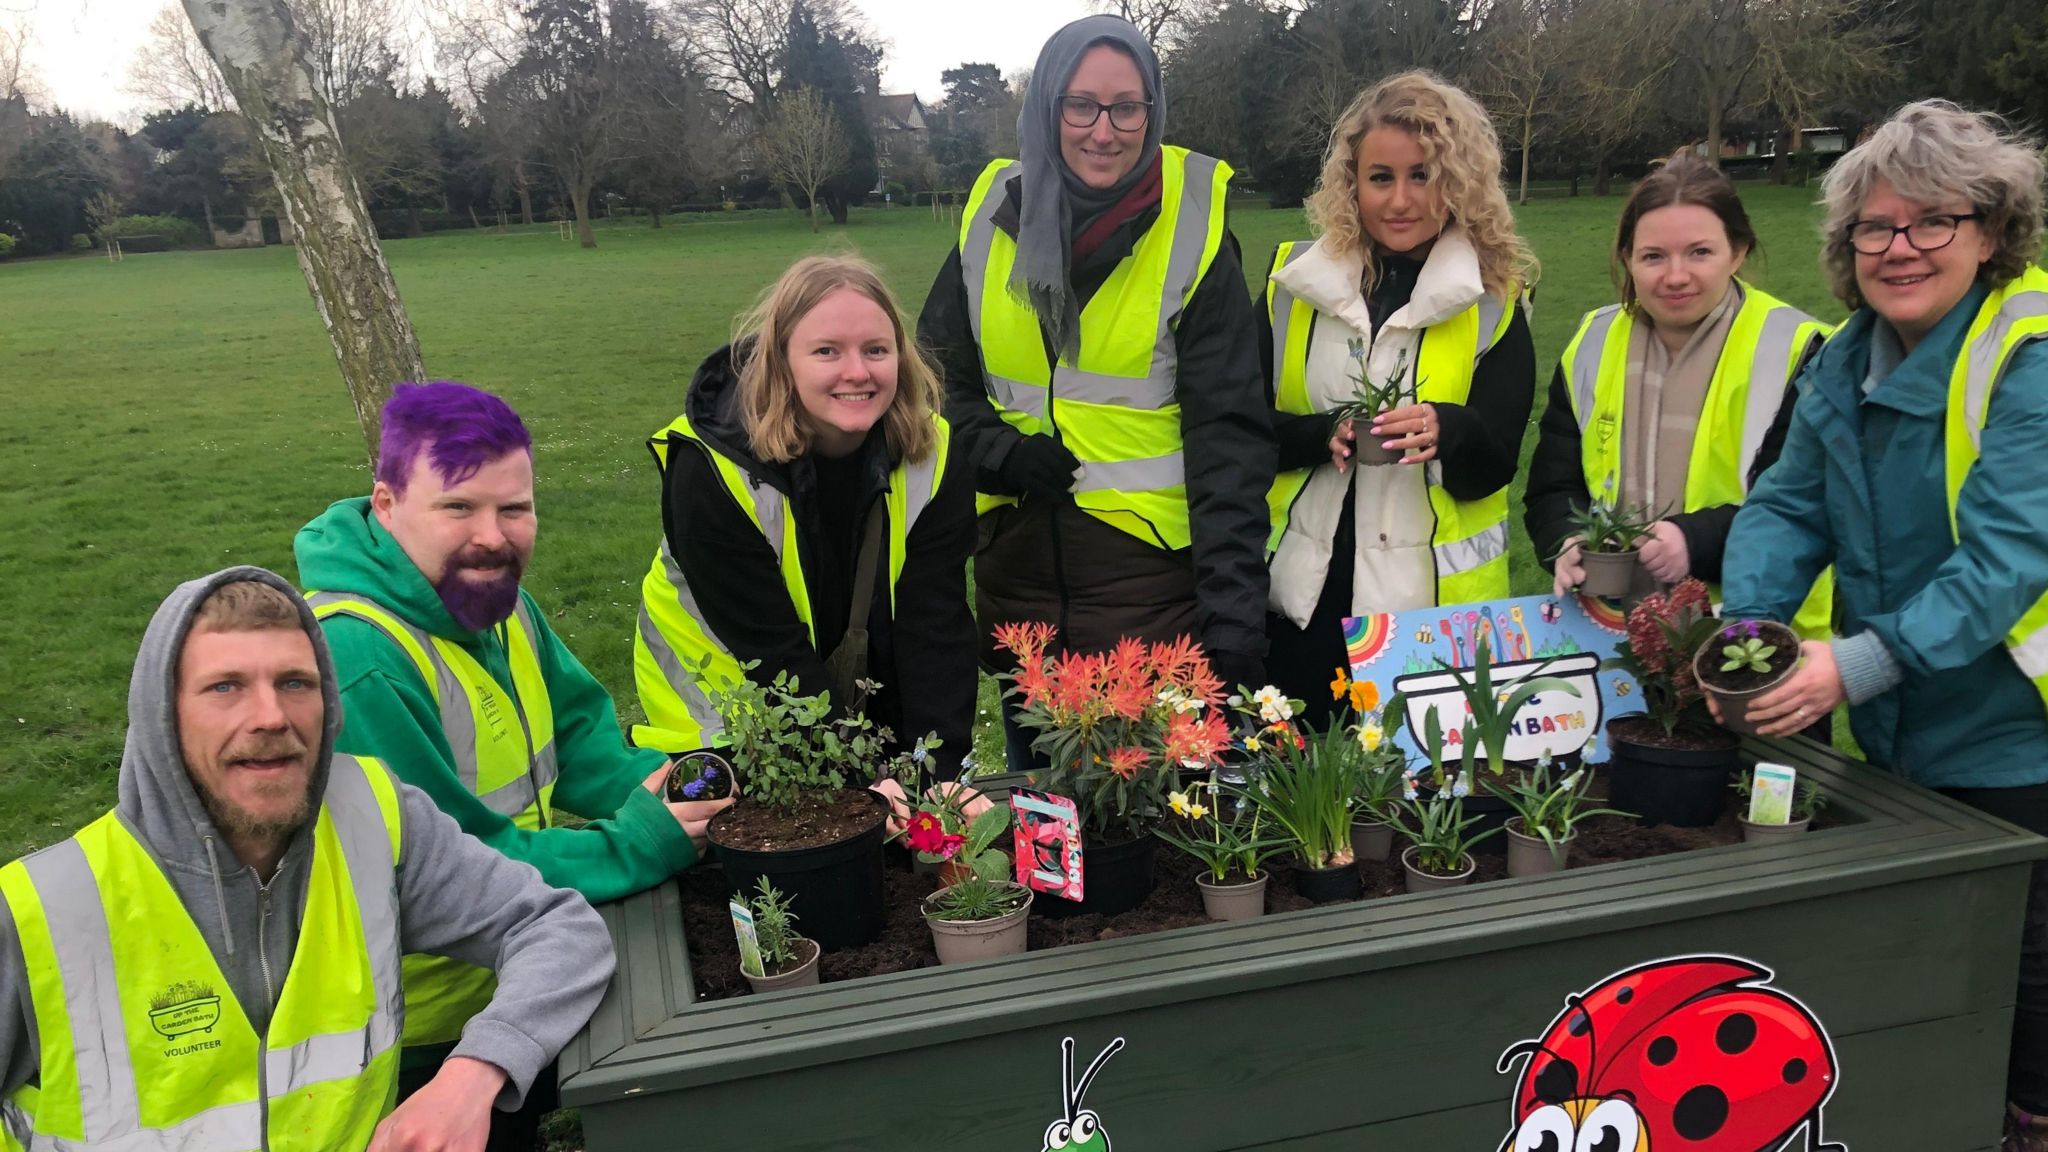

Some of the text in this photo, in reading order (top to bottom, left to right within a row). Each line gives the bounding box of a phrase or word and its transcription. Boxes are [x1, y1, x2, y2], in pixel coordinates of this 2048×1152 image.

[1526, 711, 1585, 734] BATH
[184, 1007, 199, 1015] THE
[161, 1013, 214, 1029] GARDEN BATH
[164, 1040, 221, 1057] VOLUNTEER
